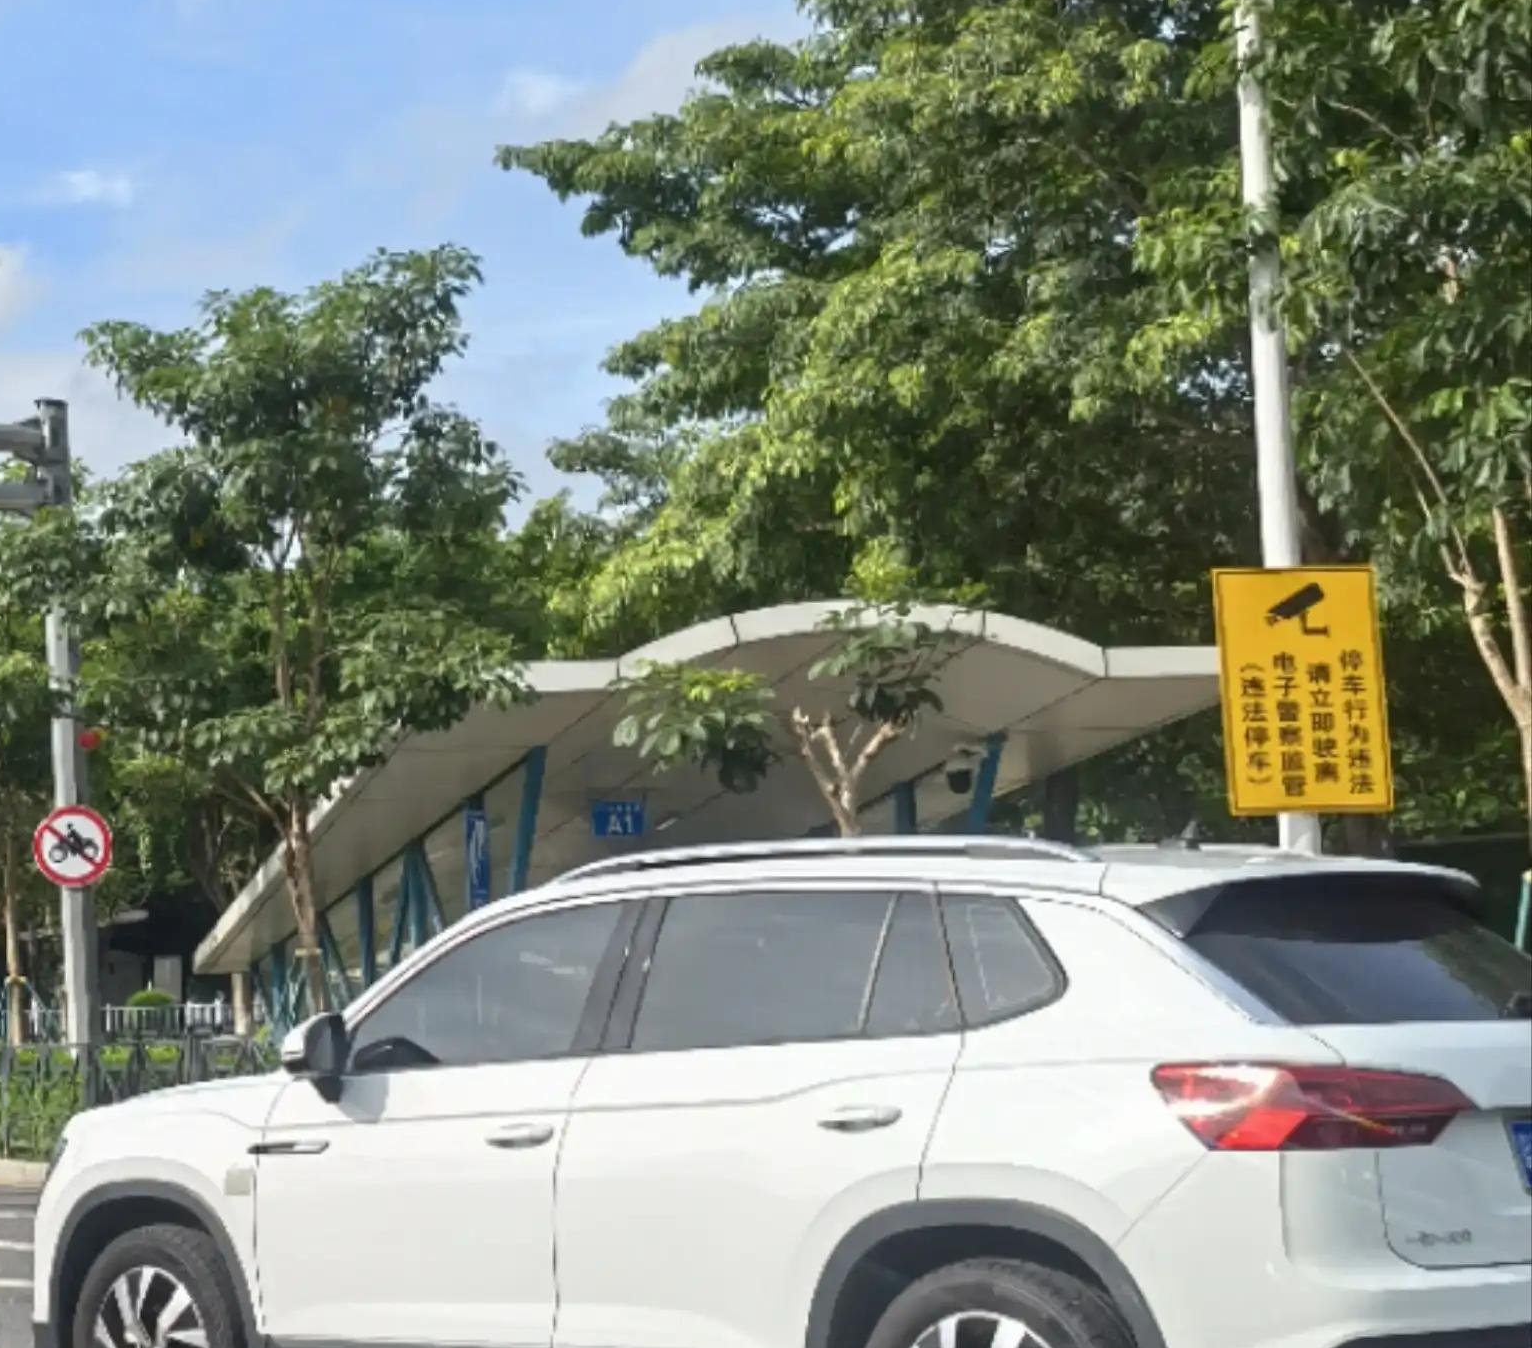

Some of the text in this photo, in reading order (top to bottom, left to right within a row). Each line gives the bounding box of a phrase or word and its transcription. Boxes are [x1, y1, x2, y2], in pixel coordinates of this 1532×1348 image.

[1339, 649, 1375, 795] 停车行为违法
[607, 813, 633, 834] A1
